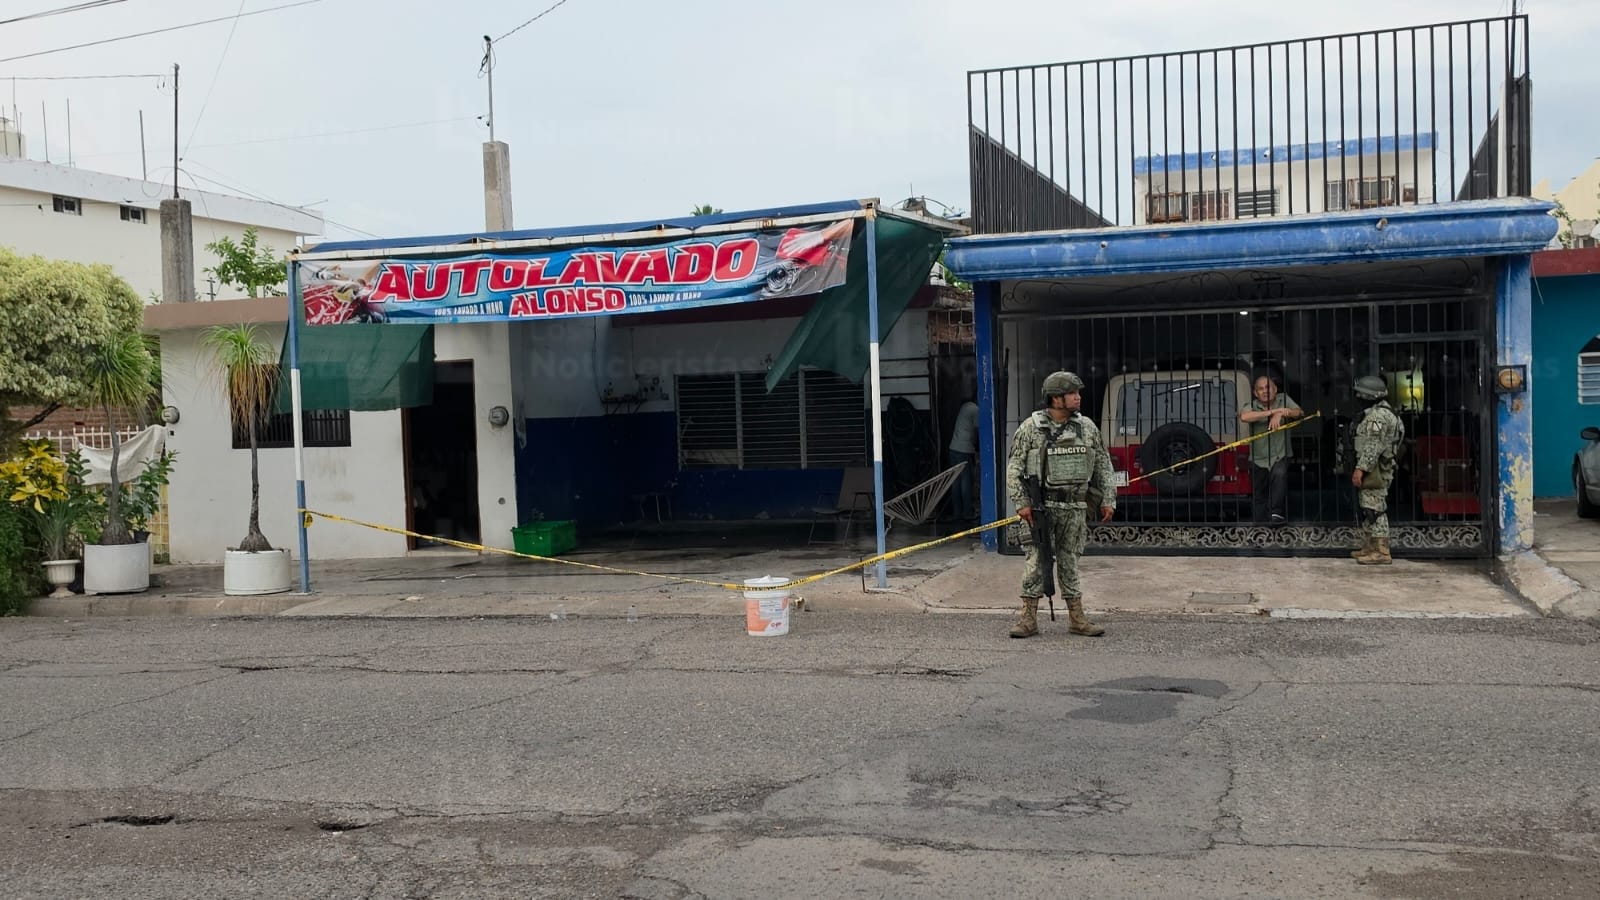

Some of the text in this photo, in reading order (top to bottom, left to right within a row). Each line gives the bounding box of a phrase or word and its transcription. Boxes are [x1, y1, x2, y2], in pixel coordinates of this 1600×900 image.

[368, 238, 760, 303] AUTOLAVADO
[454, 304, 478, 315] LAVADO
[485, 300, 504, 315] MANO
[509, 287, 626, 318] ALONSO
[629, 294, 648, 306] 100%
[649, 293, 674, 304] LAVADO
[682, 291, 702, 301] MANO
